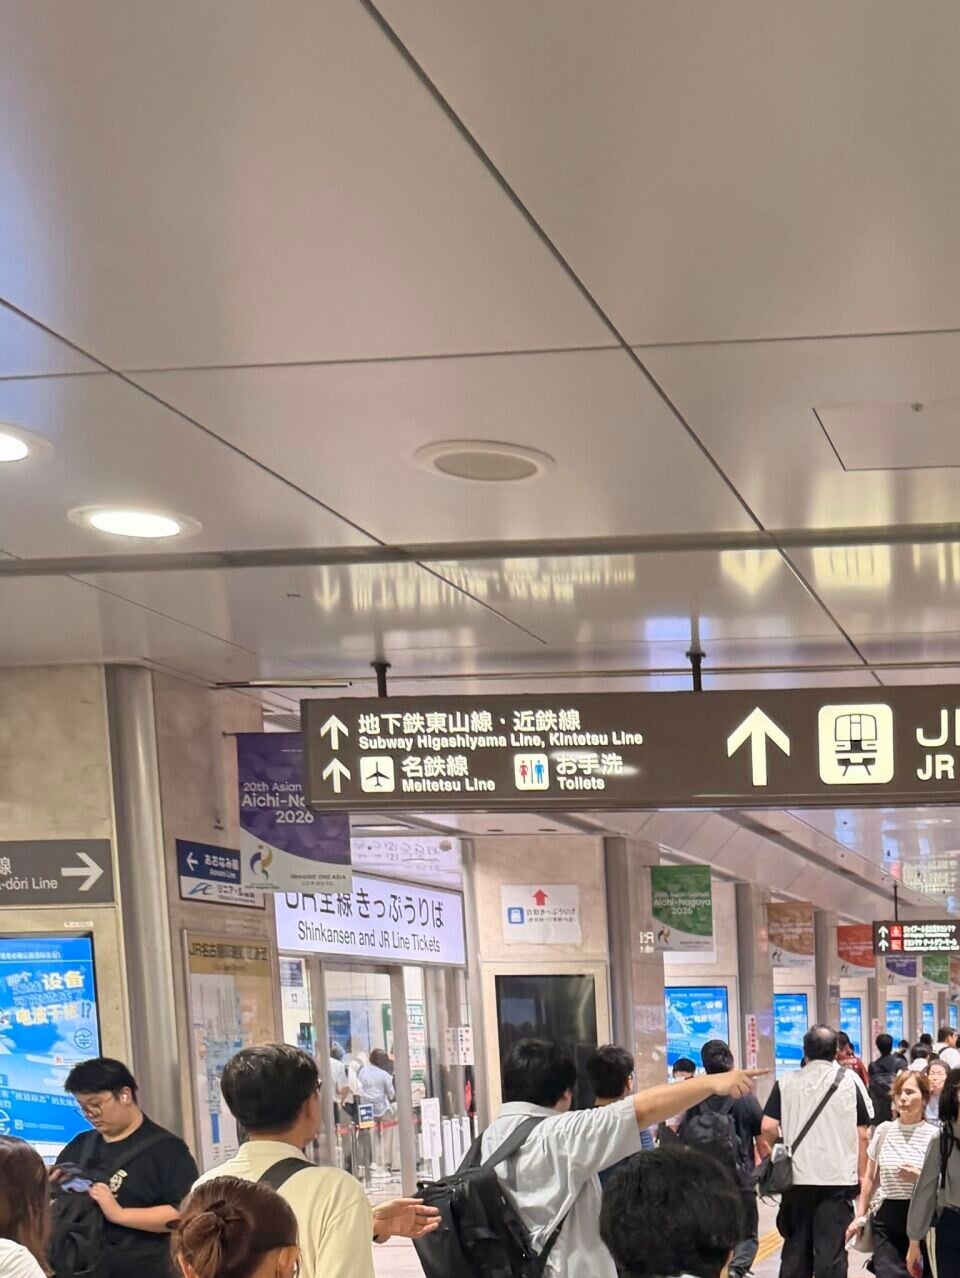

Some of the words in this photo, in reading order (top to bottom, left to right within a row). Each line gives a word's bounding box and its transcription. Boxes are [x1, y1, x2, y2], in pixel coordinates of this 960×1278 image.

[358, 735, 414, 752] Subway
[417, 734, 507, 751] Higashiyama
[510, 732, 546, 748] Line,
[549, 732, 609, 746] Kintetsu
[612, 730, 643, 745] Line
[402, 755, 469, 778] 名鉄線
[556, 752, 624, 775] お手洗
[916, 754, 955, 780] JR
[243, 782, 269, 792] 20th
[272, 781, 302, 792] Asian
[402, 778, 461, 792] Meitetsu
[465, 777, 496, 791] Line
[557, 776, 605, 790] Toilets
[276, 810, 314, 824] 2026
[32, 877, 58, 890] Line
[298, 920, 356, 946] Shinkansen
[359, 929, 375, 947] and
[379, 930, 390, 949] JR
[392, 931, 410, 950] Line
[412, 933, 441, 953] Tickets
